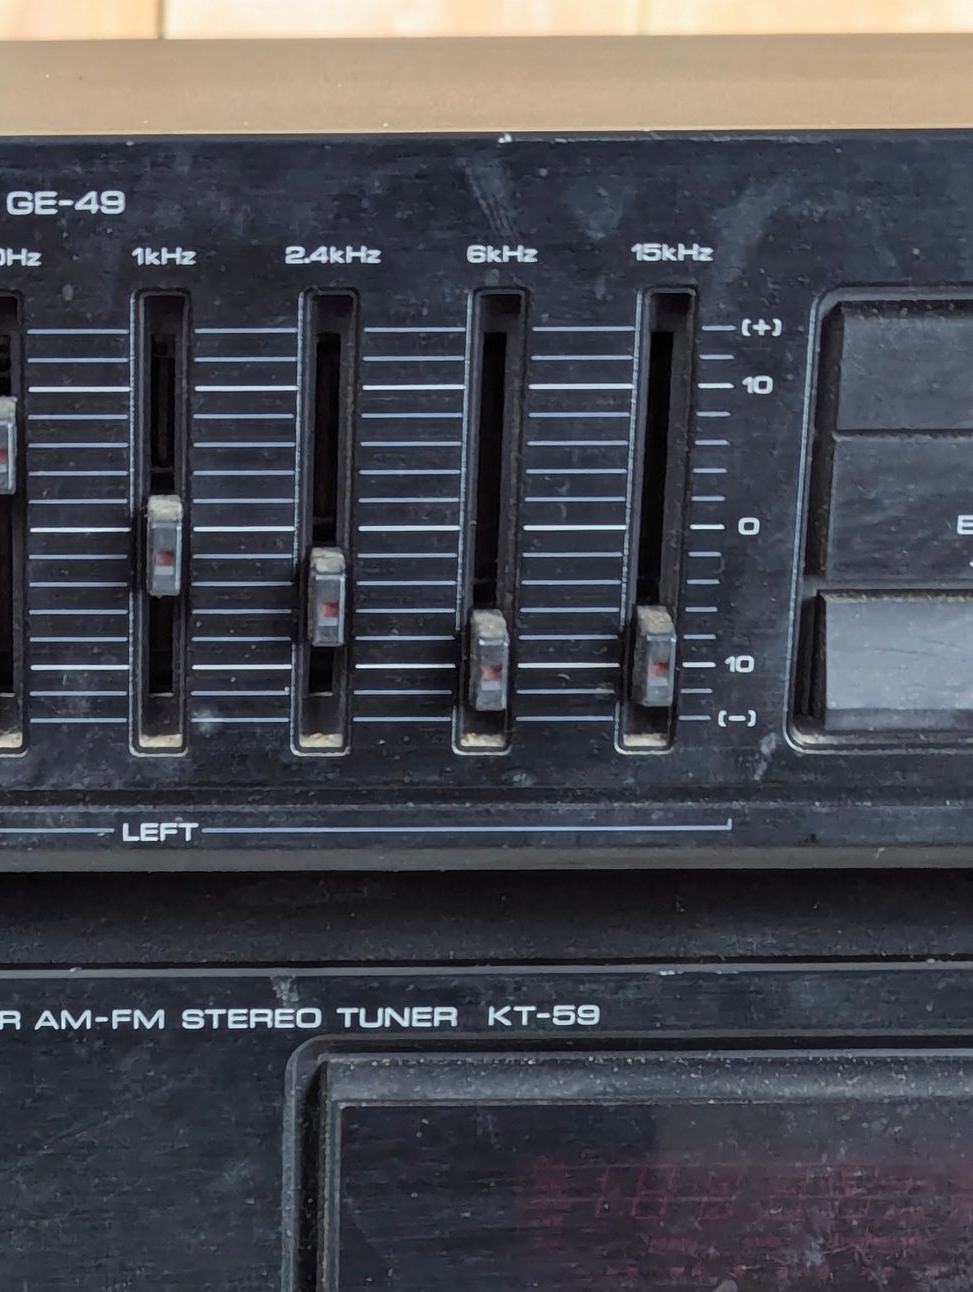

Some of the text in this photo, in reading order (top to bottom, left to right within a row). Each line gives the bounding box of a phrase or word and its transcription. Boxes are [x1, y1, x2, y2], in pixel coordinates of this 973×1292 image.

[6, 190, 126, 216] GE-49
[131, 247, 197, 266] 1kHz
[285, 245, 382, 265] 2.4kHz
[466, 244, 538, 264] 6kHz
[631, 243, 714, 262] 15kHz
[741, 318, 782, 337] (+)
[741, 375, 774, 395] 10
[737, 517, 760, 536] 0
[724, 655, 755, 673] 10
[122, 822, 199, 842] LEFT
[34, 1009, 165, 1031] AM-FM
[181, 1007, 322, 1030] STEREO
[336, 1006, 458, 1028] TUNER
[488, 1004, 600, 1026] KT-59
